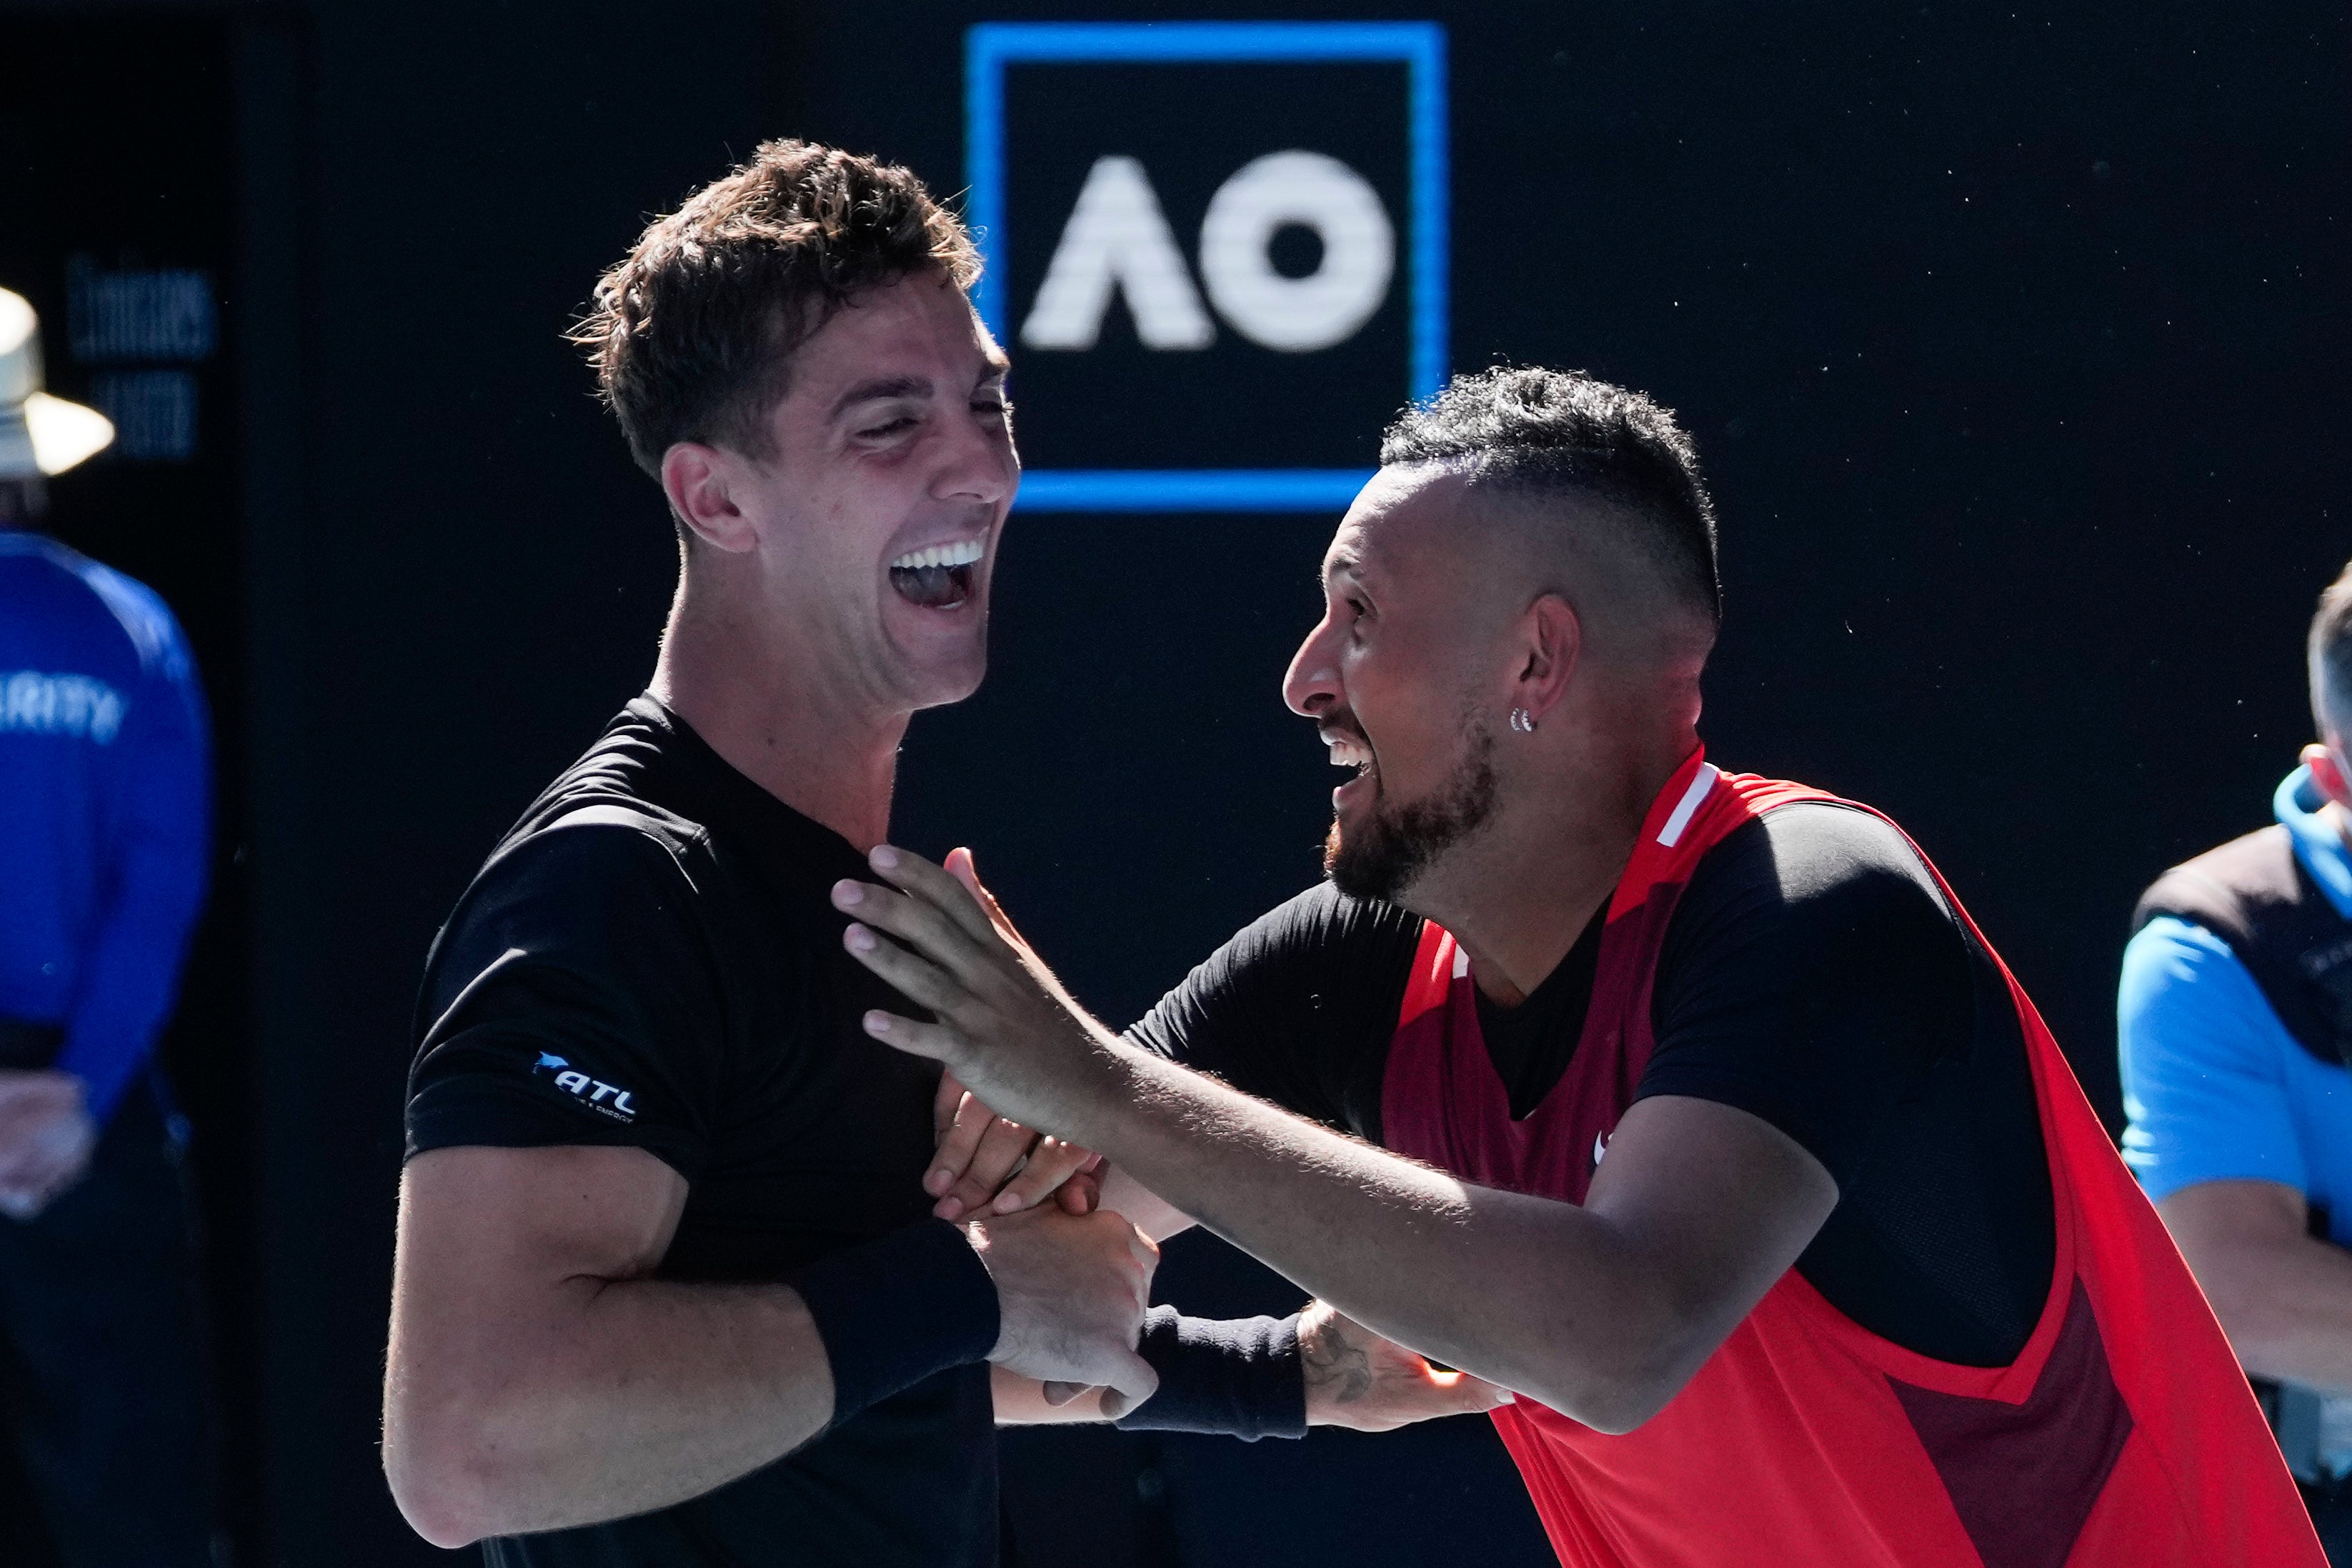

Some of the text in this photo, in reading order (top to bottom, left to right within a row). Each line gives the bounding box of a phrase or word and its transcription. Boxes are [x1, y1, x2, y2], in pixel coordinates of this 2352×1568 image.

[1021, 150, 1395, 351] AO
[0, 671, 129, 743] RITY
[554, 1071, 636, 1114] ATL
